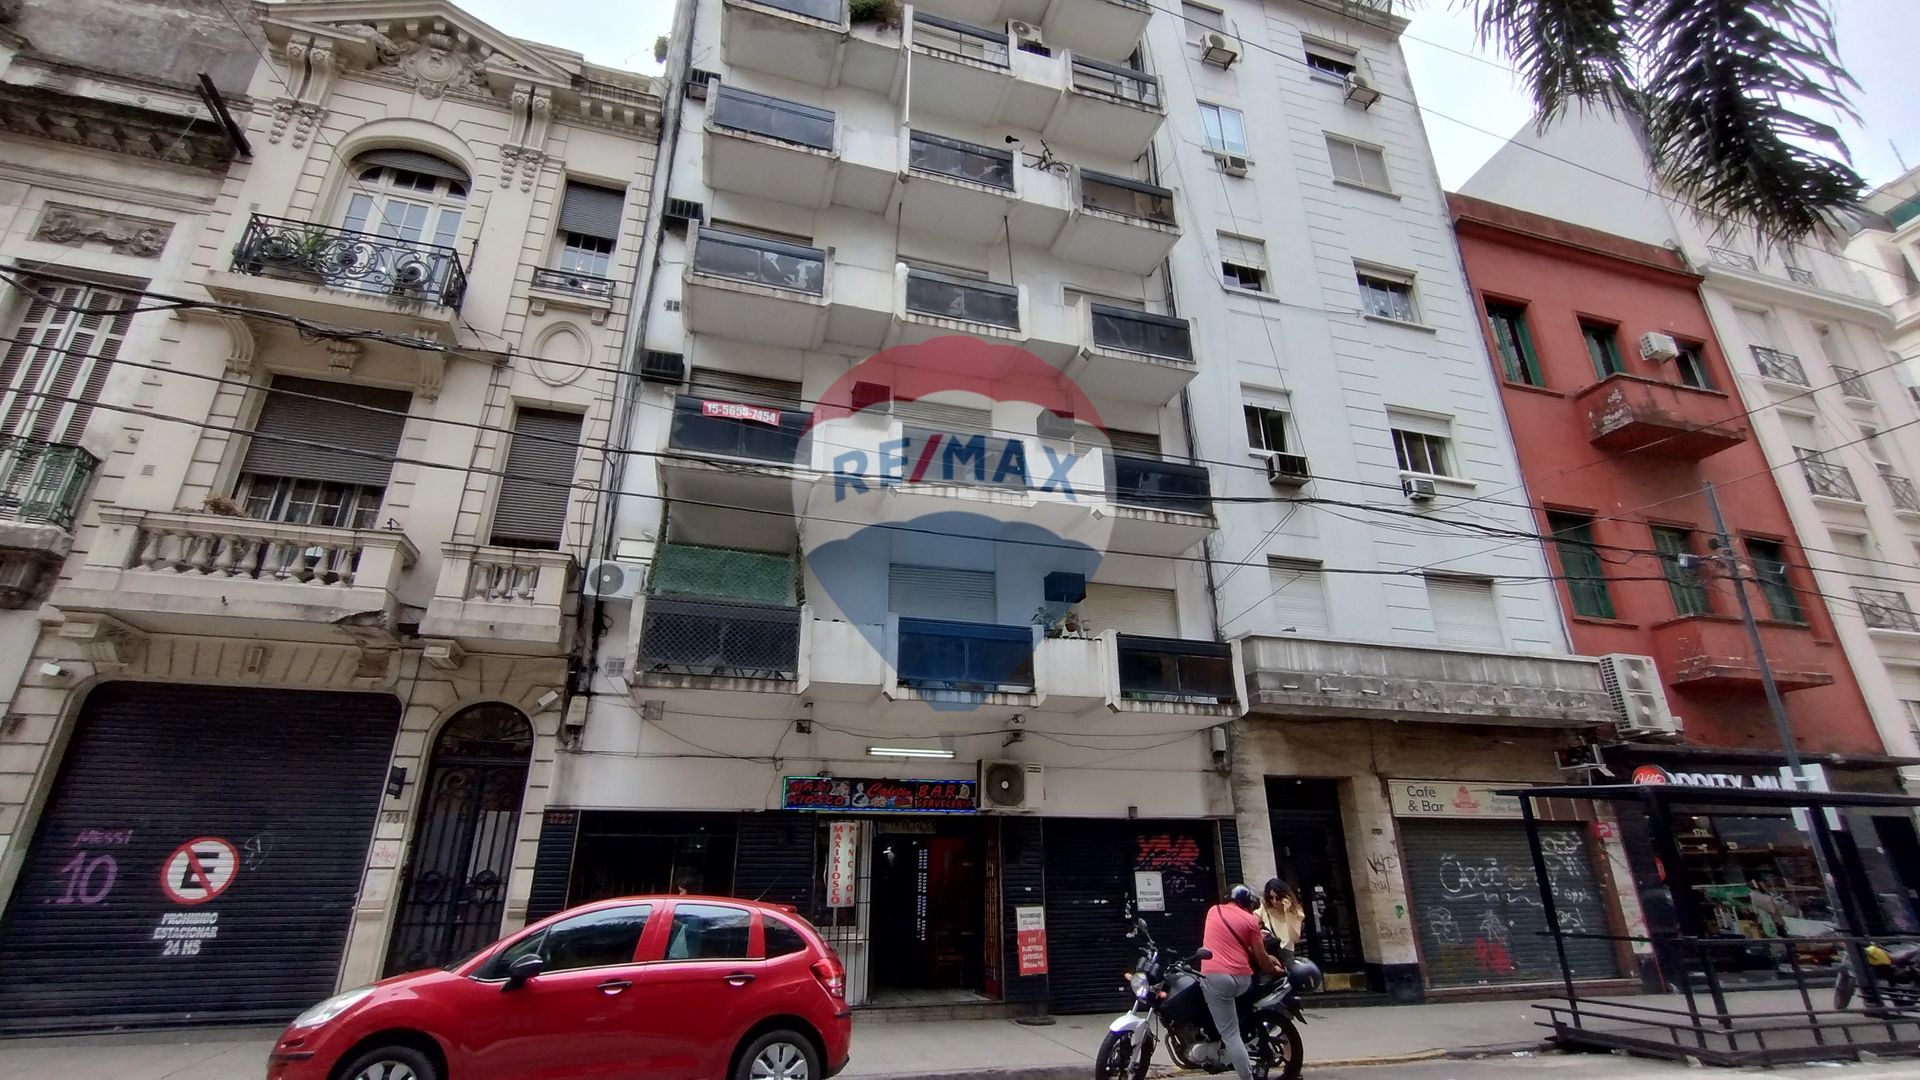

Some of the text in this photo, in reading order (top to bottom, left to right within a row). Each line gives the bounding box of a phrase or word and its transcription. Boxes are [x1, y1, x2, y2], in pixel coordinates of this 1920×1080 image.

[919, 784, 957, 798] BAR
[1422, 801, 1445, 812] Bar
[831, 825, 843, 905] MAXIKIOSCO
[161, 912, 219, 925] PROHIBIDO
[152, 926, 219, 940] ESTACIONAR
[162, 940, 202, 956] 24 HS
